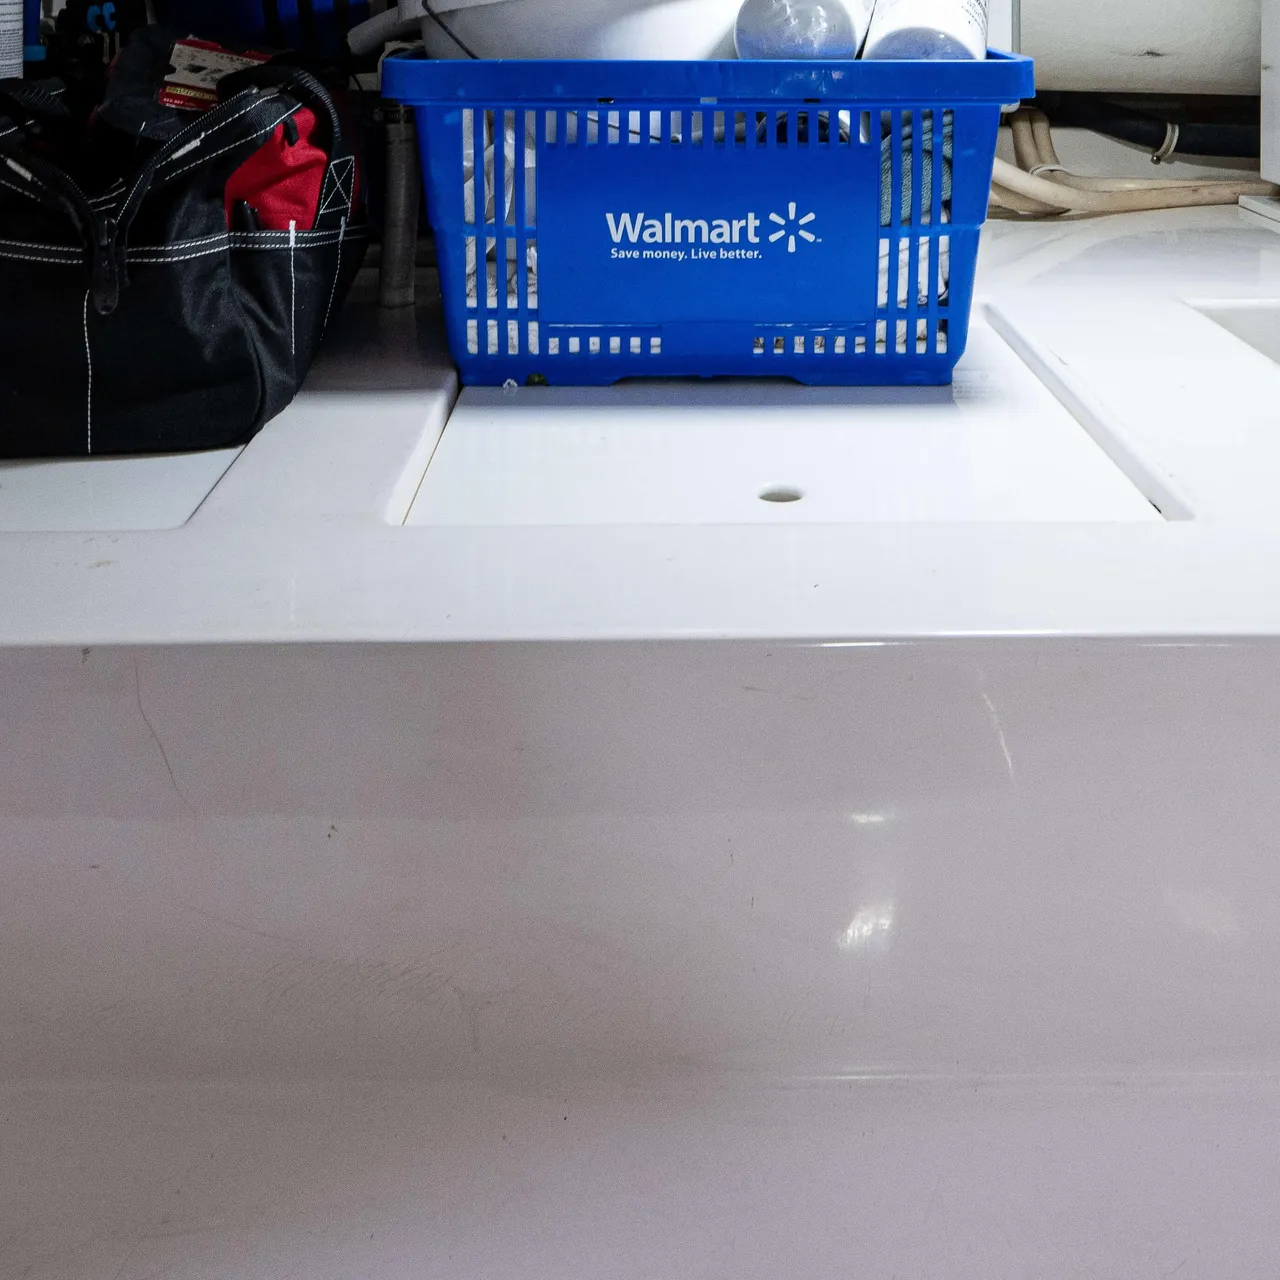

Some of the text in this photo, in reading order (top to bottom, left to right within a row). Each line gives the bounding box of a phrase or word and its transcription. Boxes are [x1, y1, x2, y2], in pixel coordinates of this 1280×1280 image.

[605, 212, 760, 244] Walmart
[610, 248, 763, 262] Save money. Live better.
